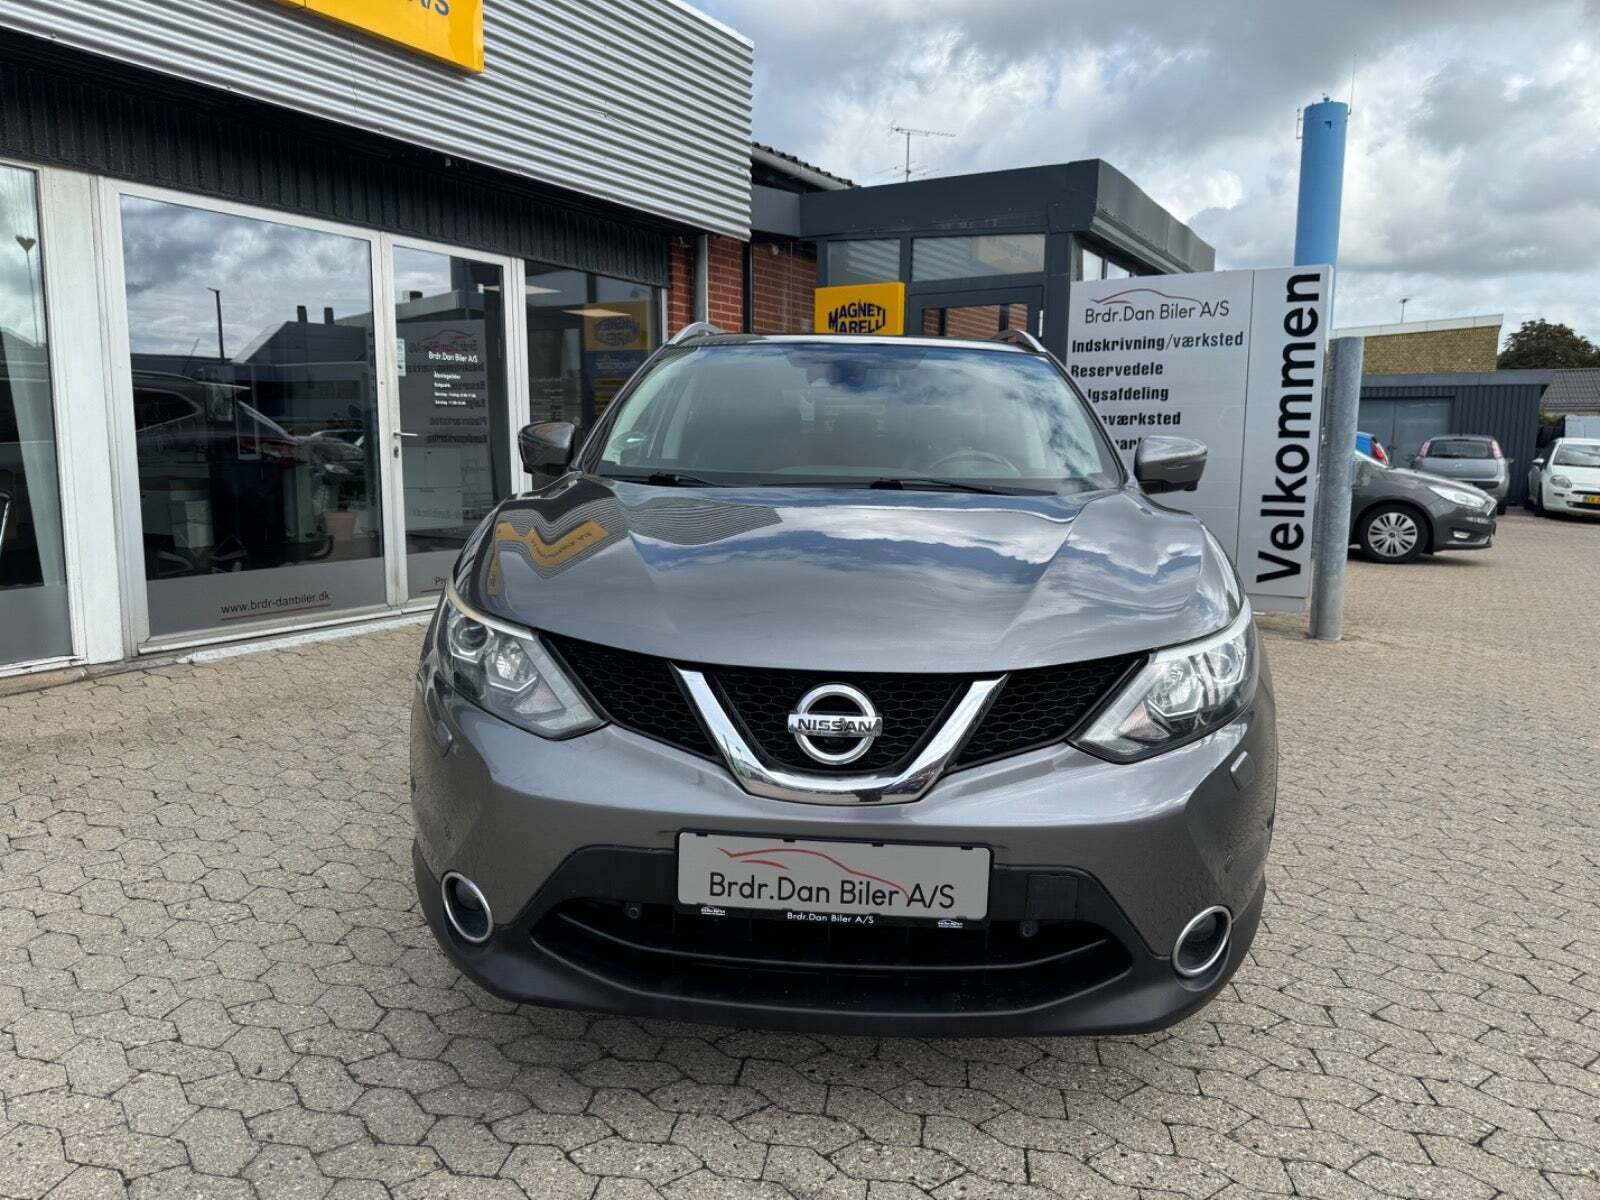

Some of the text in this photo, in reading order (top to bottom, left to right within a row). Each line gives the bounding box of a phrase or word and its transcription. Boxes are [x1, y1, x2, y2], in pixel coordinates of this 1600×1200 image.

[828, 302, 886, 331] MAGNETI
[1085, 300, 1230, 324] Brdr.Dan Biler A/S
[1072, 331, 1244, 352] Indskrivning/værksted
[1071, 362, 1163, 378] Reservedele
[1087, 386, 1169, 403] lgsafdeling
[1101, 411, 1181, 426] værksted
[1256, 272, 1321, 583] Velkommen
[220, 591, 330, 614] www.brdr-danbiler.dk
[797, 718, 873, 732] NISSAN
[709, 872, 955, 909] Brdr.Dan Biler A/S
[831, 914, 851, 923] Biler
[855, 916, 874, 924] A/S
